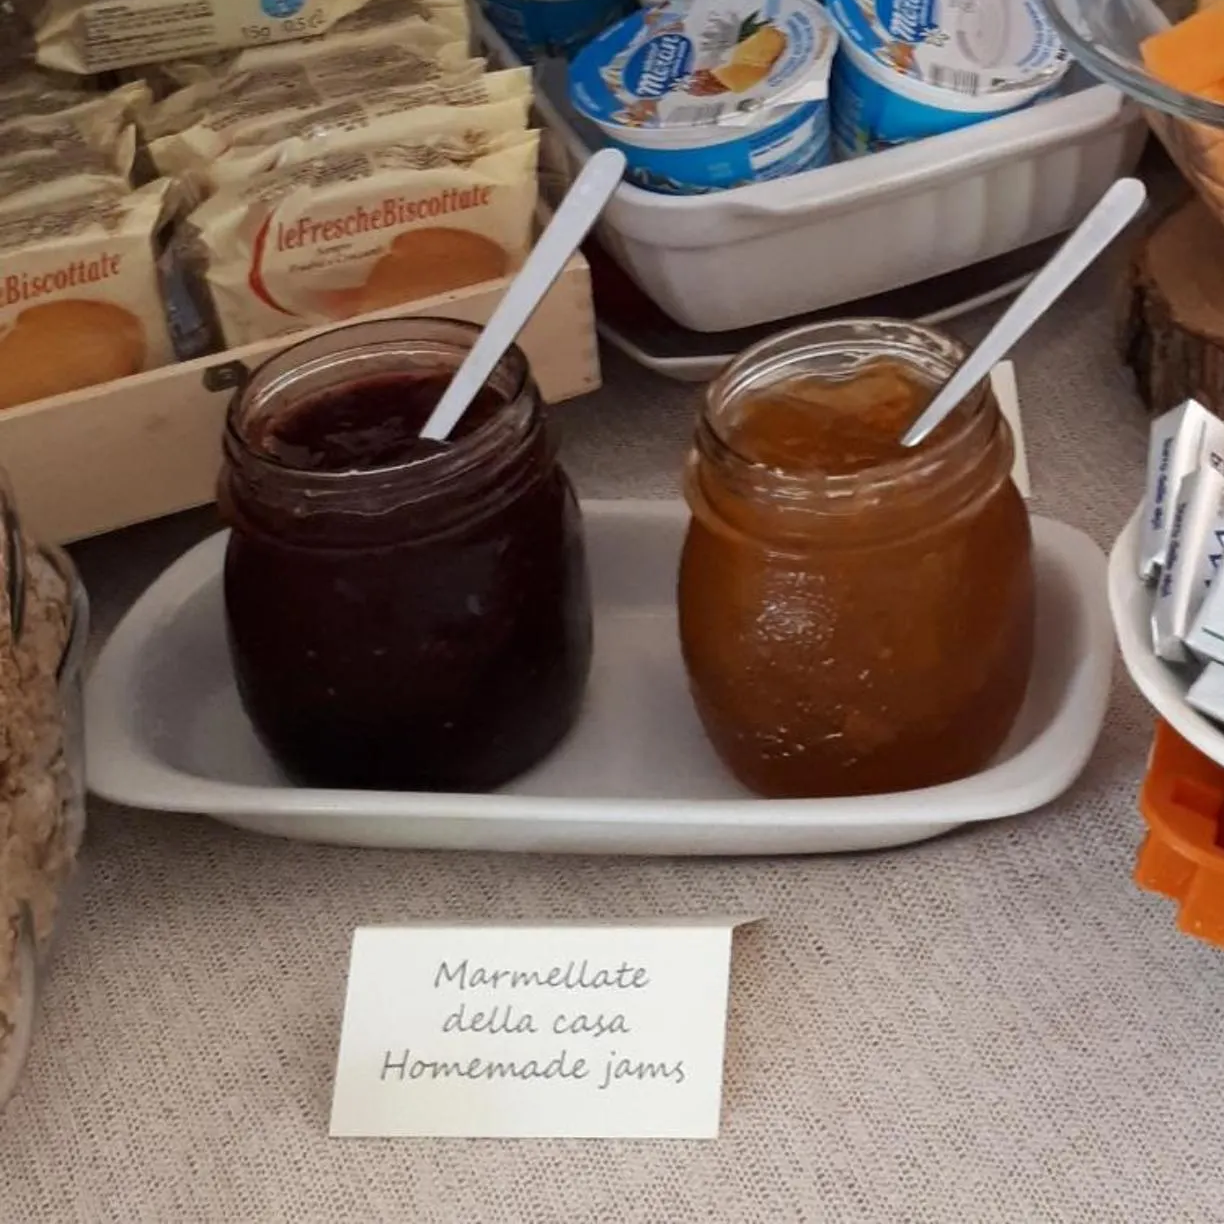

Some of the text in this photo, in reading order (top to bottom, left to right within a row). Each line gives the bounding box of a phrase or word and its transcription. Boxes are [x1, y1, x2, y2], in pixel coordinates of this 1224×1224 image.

[433, 959, 650, 992] Marmellate
[440, 1003, 632, 1038] della casa
[379, 1050, 688, 1090] Homemade jams
